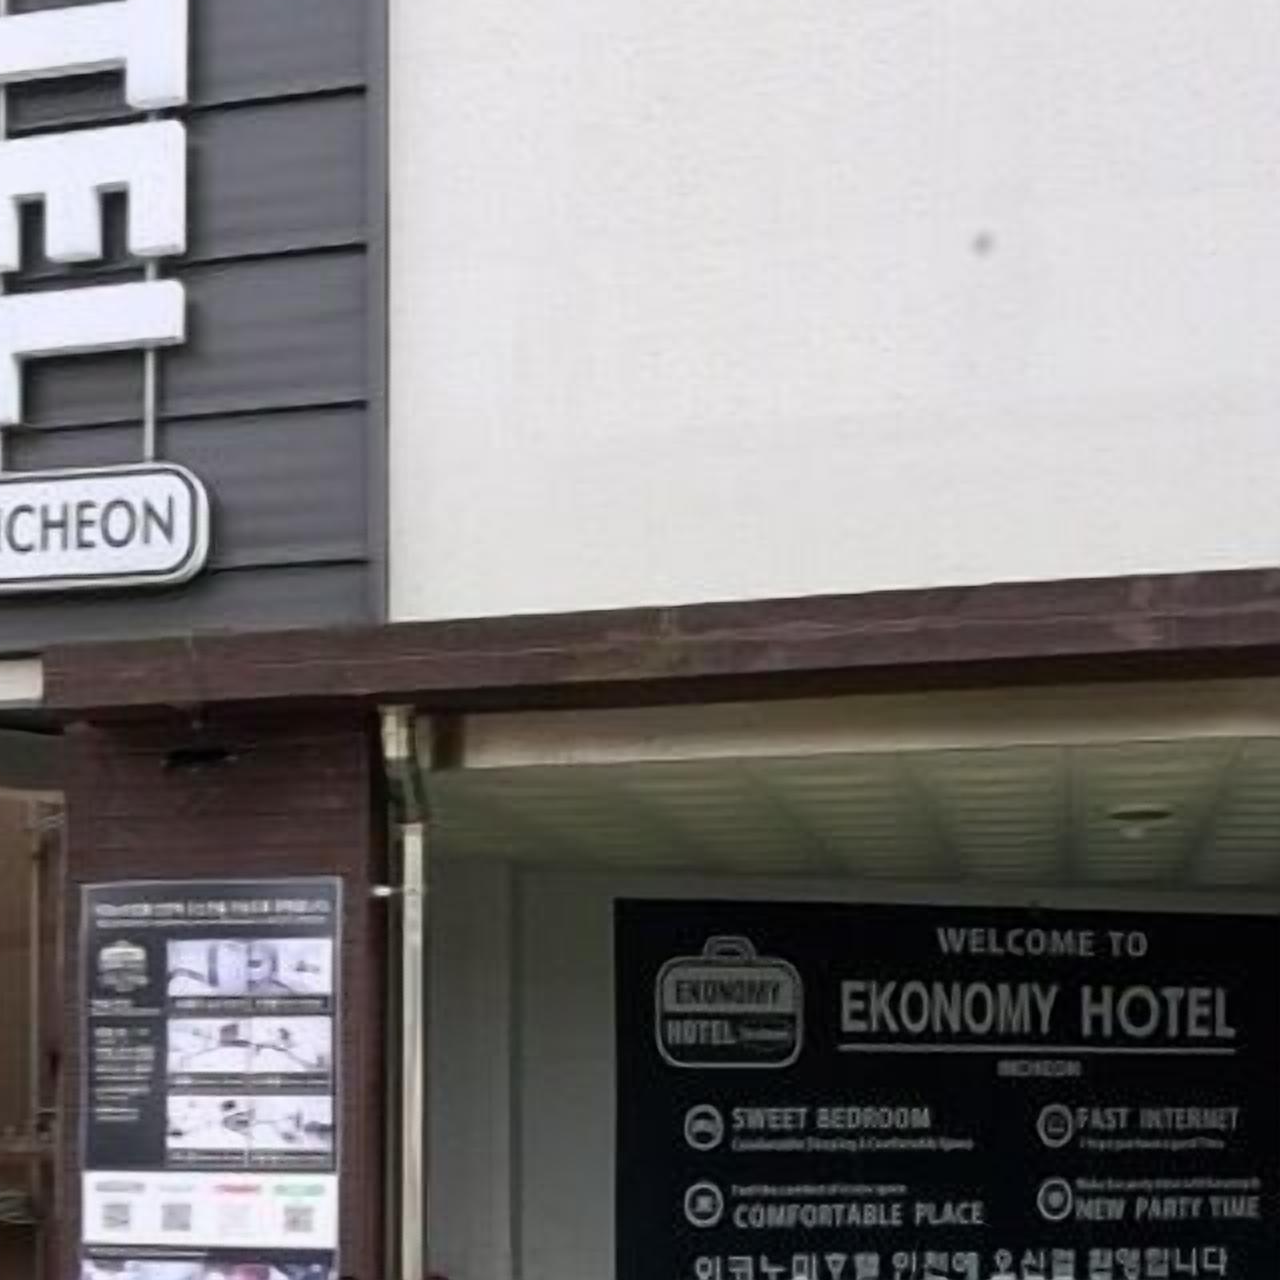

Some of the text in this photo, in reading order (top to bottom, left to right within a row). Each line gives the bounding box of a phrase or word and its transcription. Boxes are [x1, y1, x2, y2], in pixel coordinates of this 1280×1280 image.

[936, 927, 1149, 957] WELCOME TO
[840, 980, 1237, 1039] EKONOMY HOTEL
[732, 1107, 932, 1130] SWEET BEDROOM
[1076, 1107, 1239, 1130] FAST INTERNET
[732, 1201, 984, 1228] COMFORTABLE PLACE
[1076, 1195, 1261, 1220] NEW PARTY TIME
